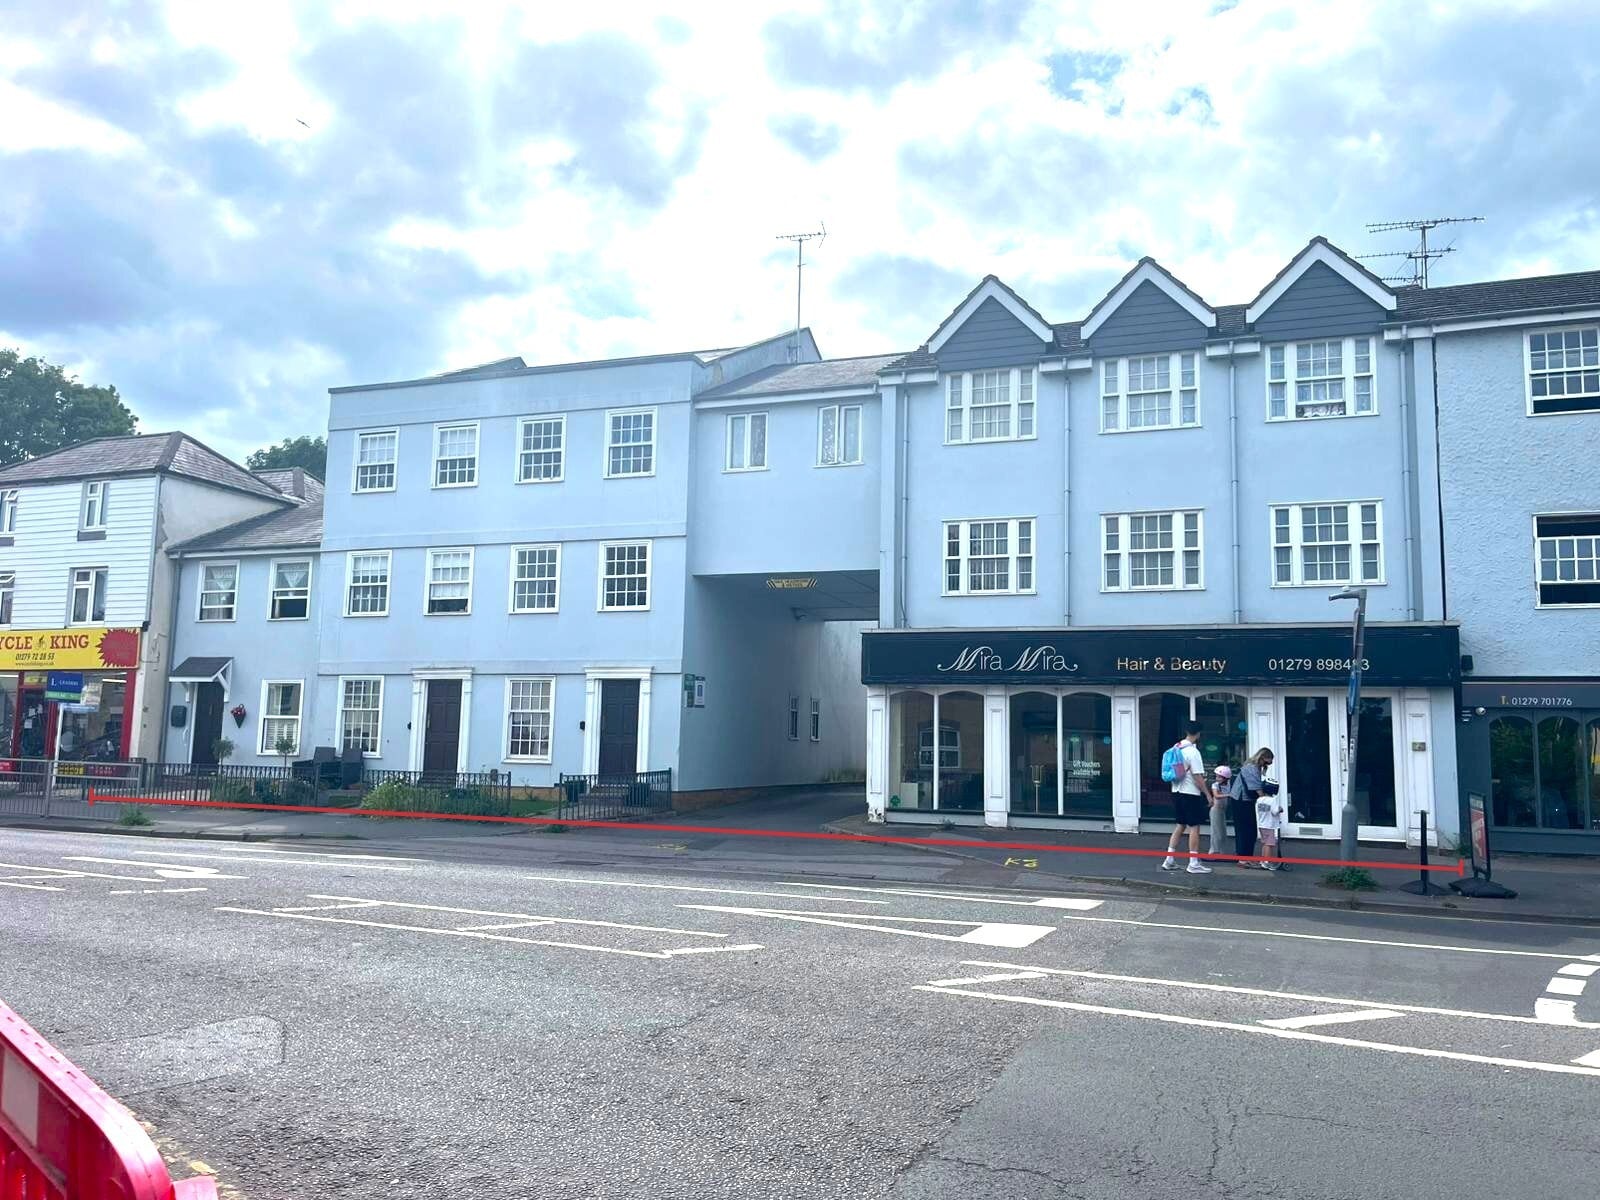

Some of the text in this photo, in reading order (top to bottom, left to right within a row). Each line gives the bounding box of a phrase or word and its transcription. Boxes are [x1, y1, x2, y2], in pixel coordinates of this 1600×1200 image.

[50, 635, 89, 649] KING
[937, 645, 1079, 671] Mira Mira
[1117, 656, 1226, 674] Hair & Beauty
[1268, 658, 1312, 671] 01279
[1511, 697, 1539, 706] 01279
[1541, 697, 1573, 706] 701776
